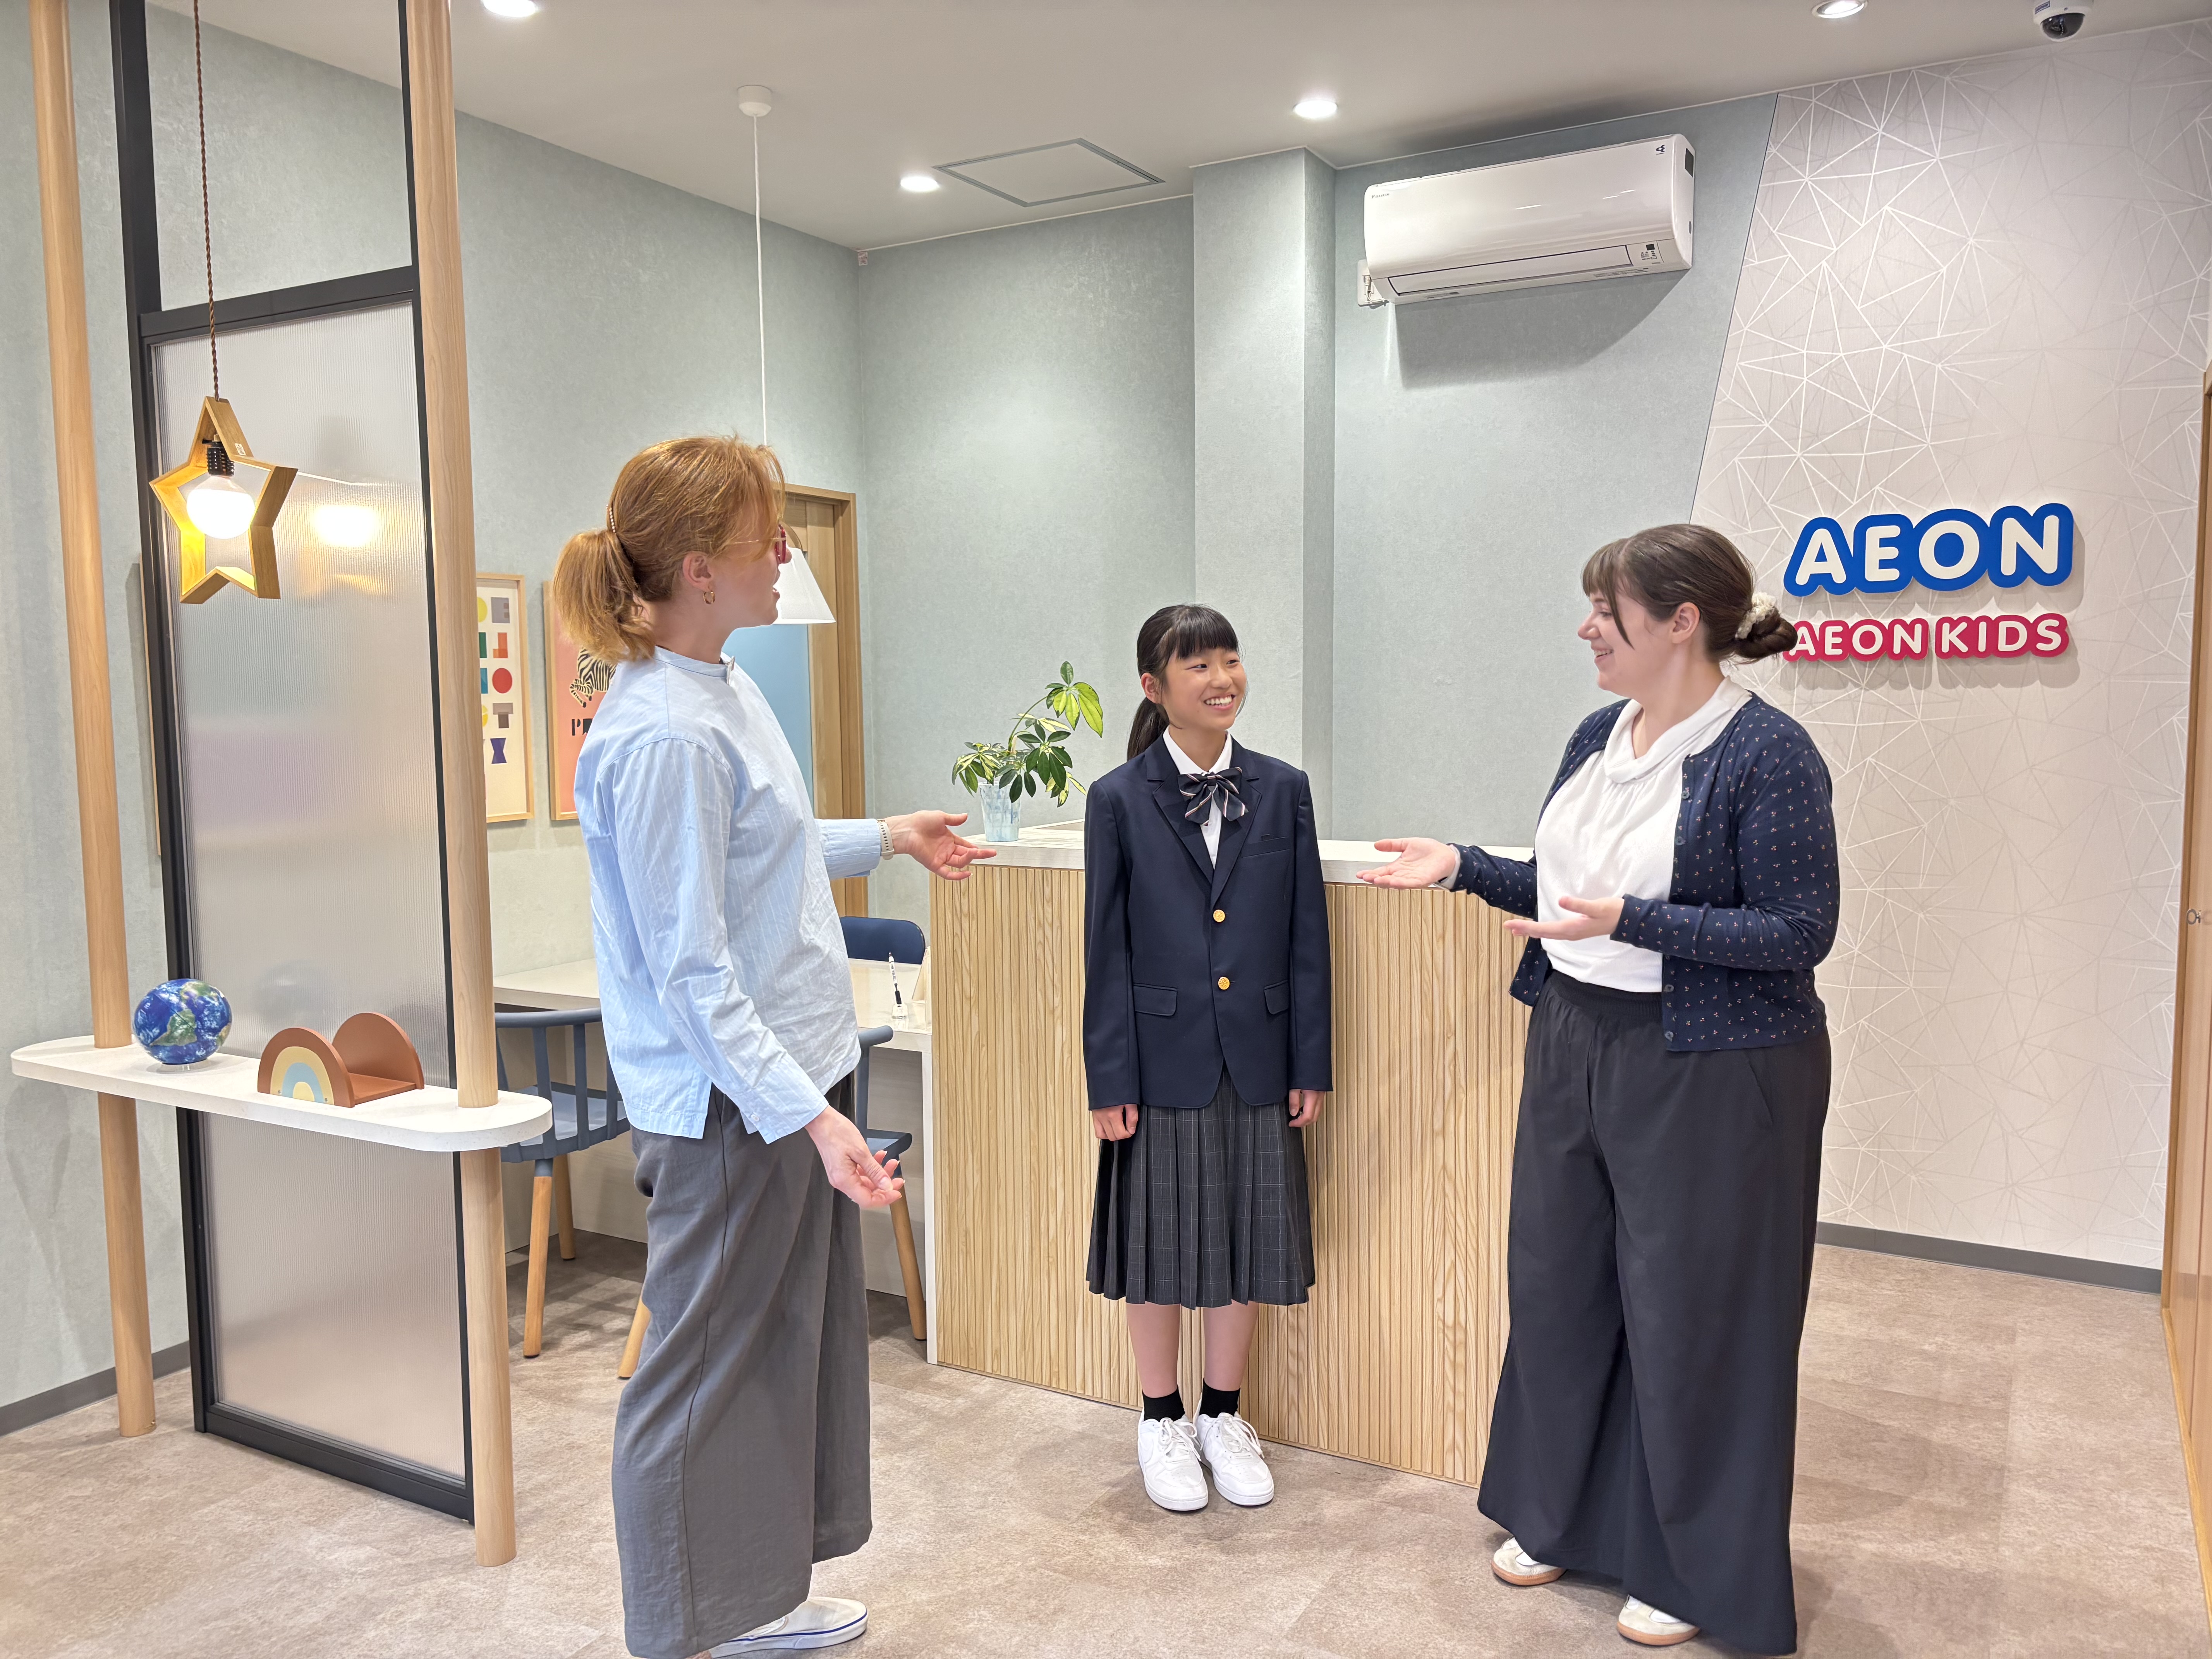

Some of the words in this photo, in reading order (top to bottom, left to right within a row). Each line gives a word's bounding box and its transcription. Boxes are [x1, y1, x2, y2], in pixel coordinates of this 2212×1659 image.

[1795, 515, 2059, 586] AEON
[1788, 623, 1922, 656] AEON
[1941, 619, 2062, 653] KIDS
